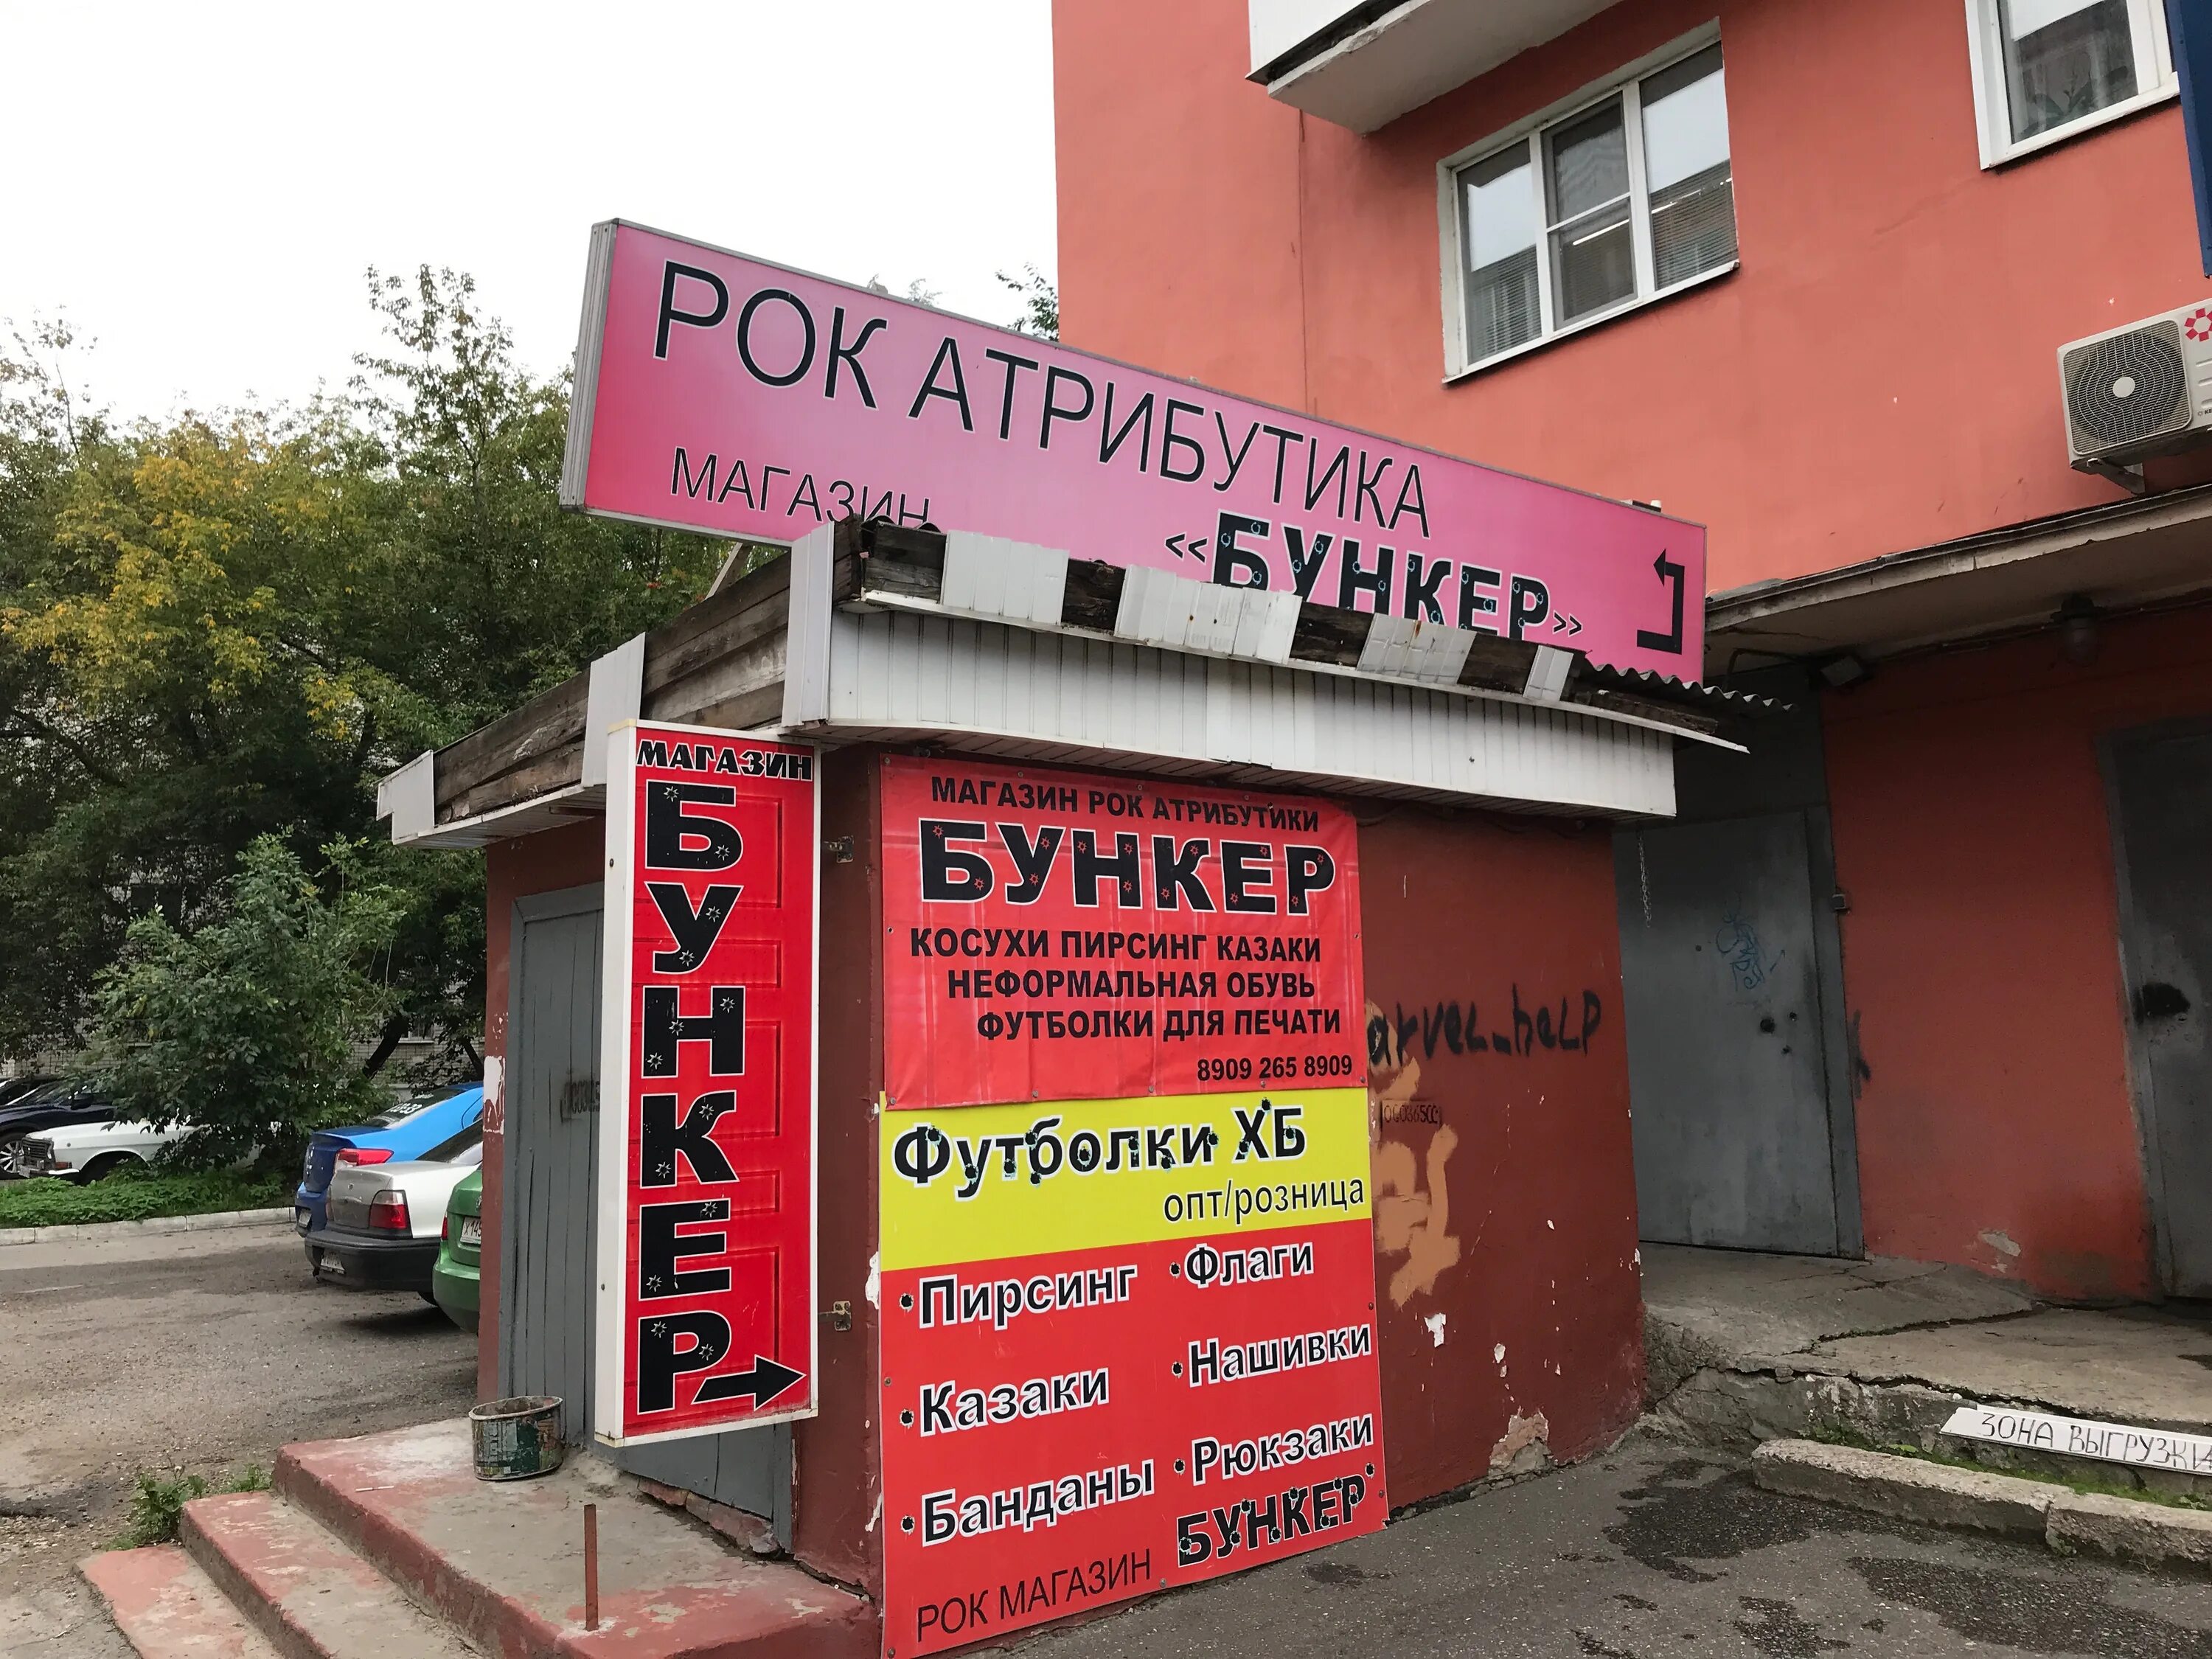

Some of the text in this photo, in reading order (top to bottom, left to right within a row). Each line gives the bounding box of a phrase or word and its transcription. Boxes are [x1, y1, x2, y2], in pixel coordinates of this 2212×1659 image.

[653, 260, 1430, 538] РОК АТРИБУТИКА
[670, 446, 931, 526] МАГАЗИН
[636, 739, 813, 782] МАГАЗИН
[931, 776, 1319, 832] МАГАЗИН РОК АТРИБУТИКИ
[919, 817, 1336, 917] БУНКЕР
[911, 928, 1321, 962] КОСУХИ ПИРСИНГ КАЗАКИ
[948, 970, 1315, 999] НЕФОРМАЛЬНАЯ ОБУВЬ
[977, 1009, 1340, 1041] ФУТБОЛКИ ДЛЯ ПЕЧАТИ
[636, 779, 745, 1416] БУНКЕР
[1197, 1055, 1353, 1082] 8909 265 8909
[891, 1103, 1307, 1200] Футболки ХБ
[1163, 1177, 1365, 1225] опт/розница
[919, 1264, 1138, 1330] Пирсинг
[1183, 1241, 1314, 1288] Флаги
[1188, 1323, 1372, 1387] Нашивки
[919, 1367, 1110, 1438] Казаки
[1980, 1412, 2053, 1447] ЗОНА
[1191, 1413, 1374, 1487] Рюкзаки
[922, 1458, 1155, 1548] Банданы
[1176, 1473, 1367, 1568] БУНКЕР
[917, 1548, 1152, 1642] РОК МАГАЗИН
